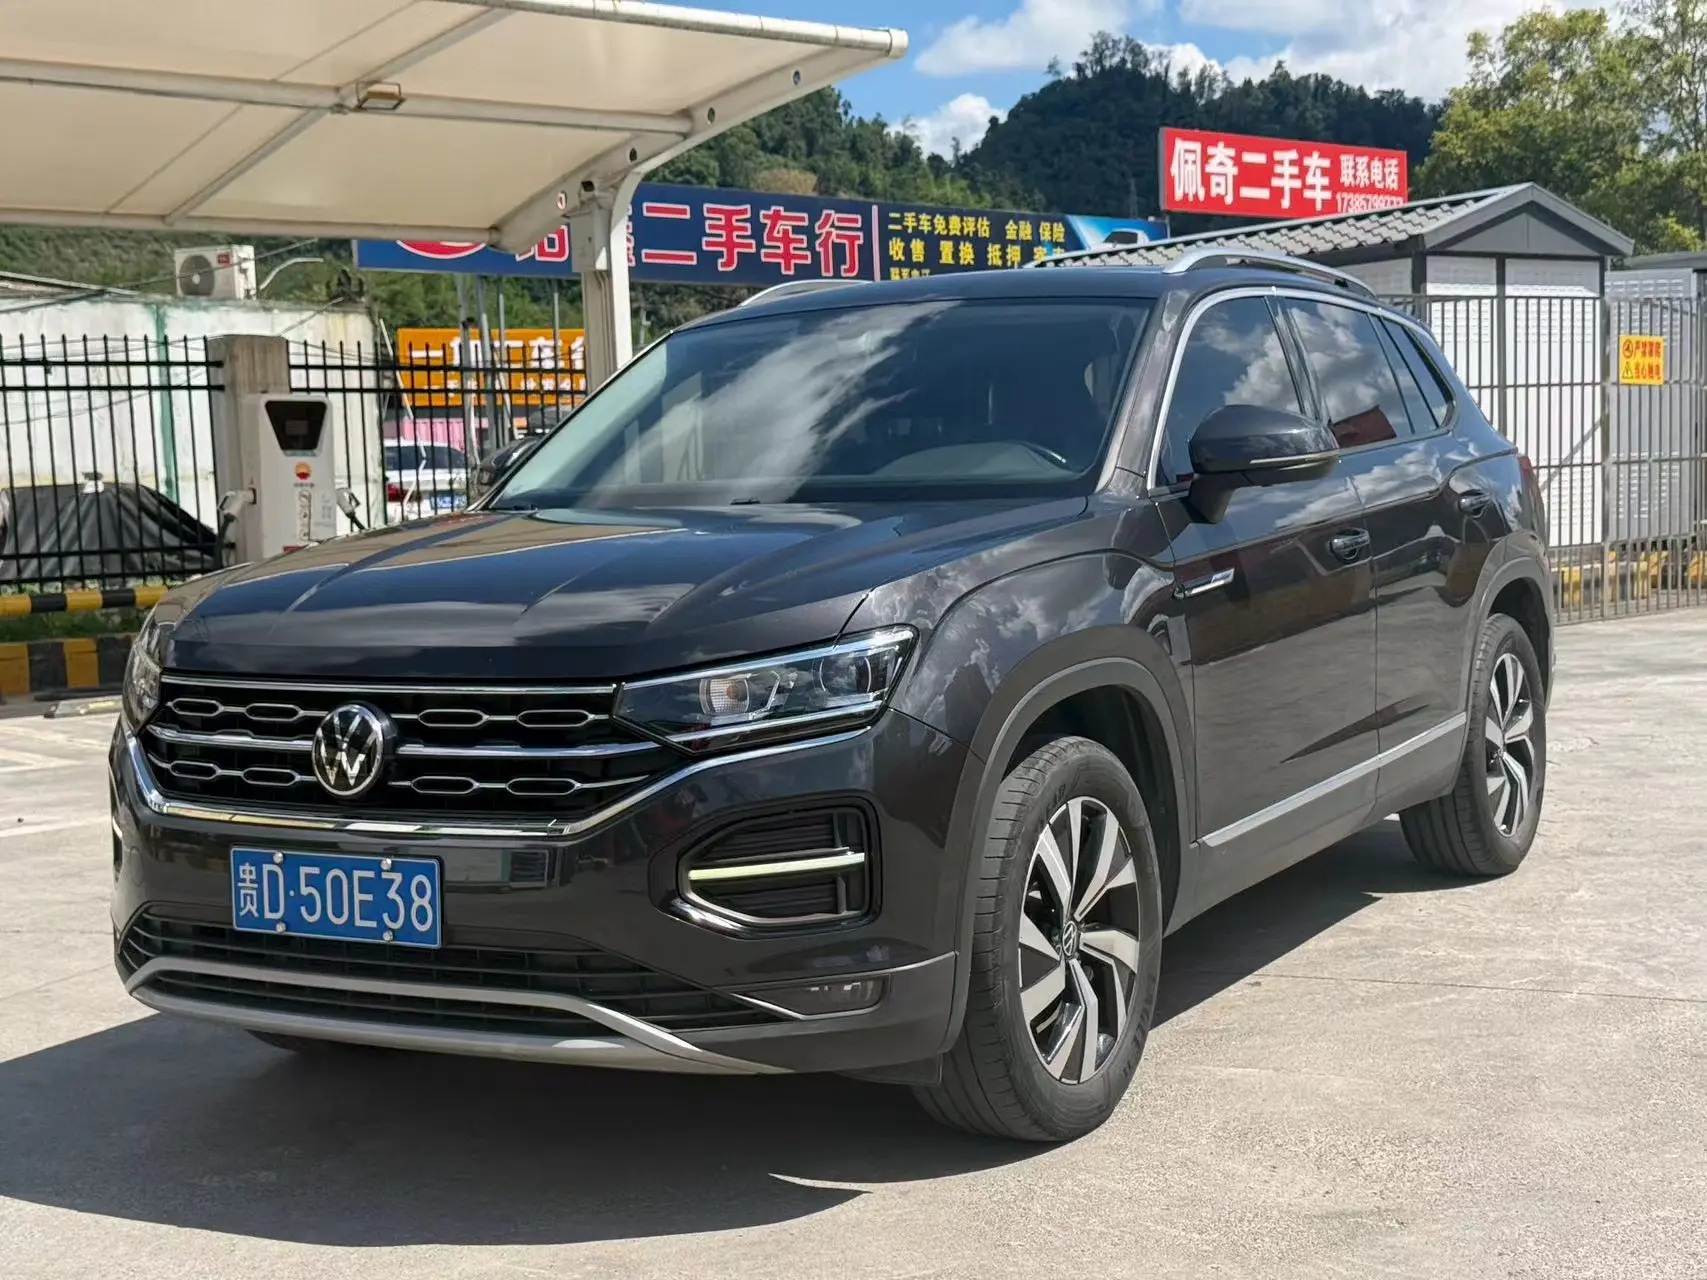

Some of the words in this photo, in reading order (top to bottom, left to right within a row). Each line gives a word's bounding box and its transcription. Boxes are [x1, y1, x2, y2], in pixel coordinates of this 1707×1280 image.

[1170, 137, 1332, 211] 佩奇二手车
[1340, 154, 1399, 190] 联系电话
[888, 212, 990, 239] 二手车免费评估
[1005, 219, 1032, 241] 金融
[1039, 221, 1065, 242] 保险
[889, 238, 925, 263] 收售
[939, 240, 975, 266] 置换
[987, 243, 1021, 268] 抵押
[237, 862, 433, 932] 贵D·50E38
